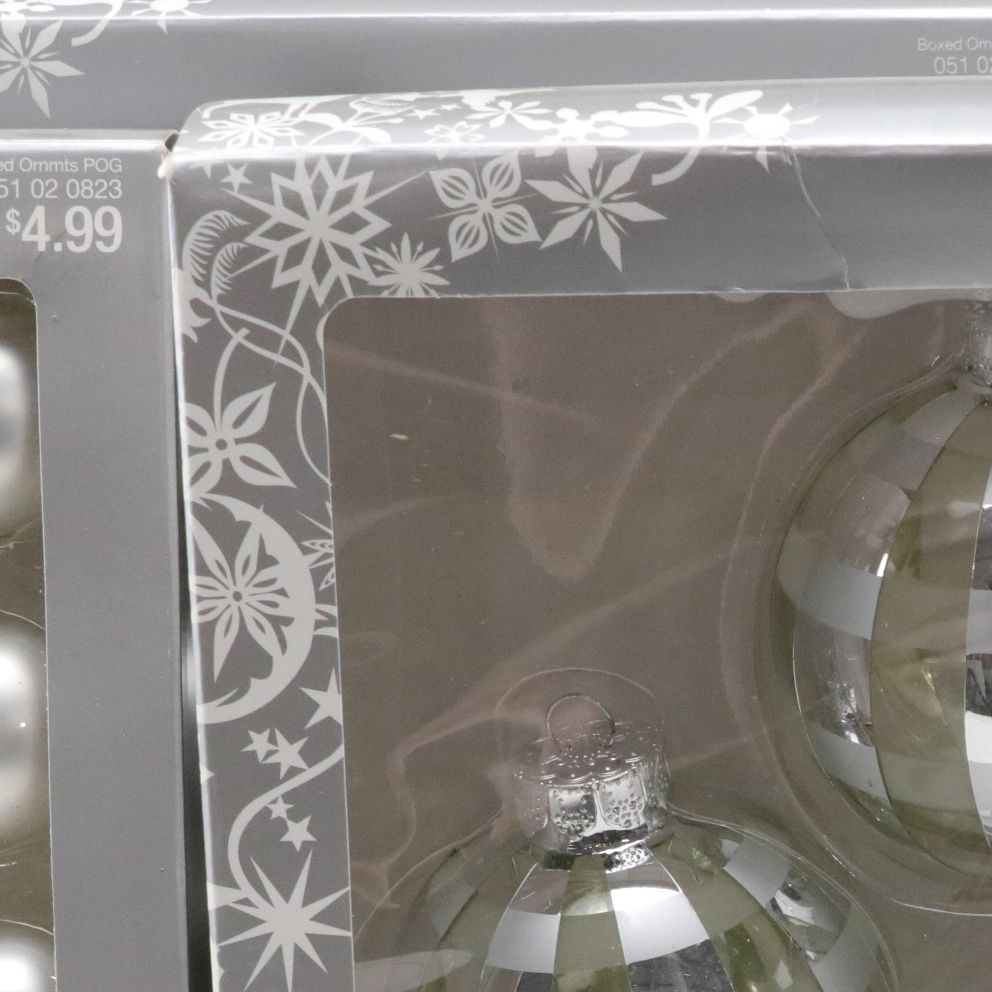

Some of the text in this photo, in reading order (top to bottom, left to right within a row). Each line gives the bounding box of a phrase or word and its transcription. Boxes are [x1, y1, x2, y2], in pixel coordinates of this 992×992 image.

[918, 38, 962, 51] Boxed
[934, 56, 968, 74] 051
[19, 157, 79, 172] Ornmts
[84, 157, 122, 172] POG
[0, 178, 122, 199] 51 02 0823
[5, 205, 123, 253] $4.99
